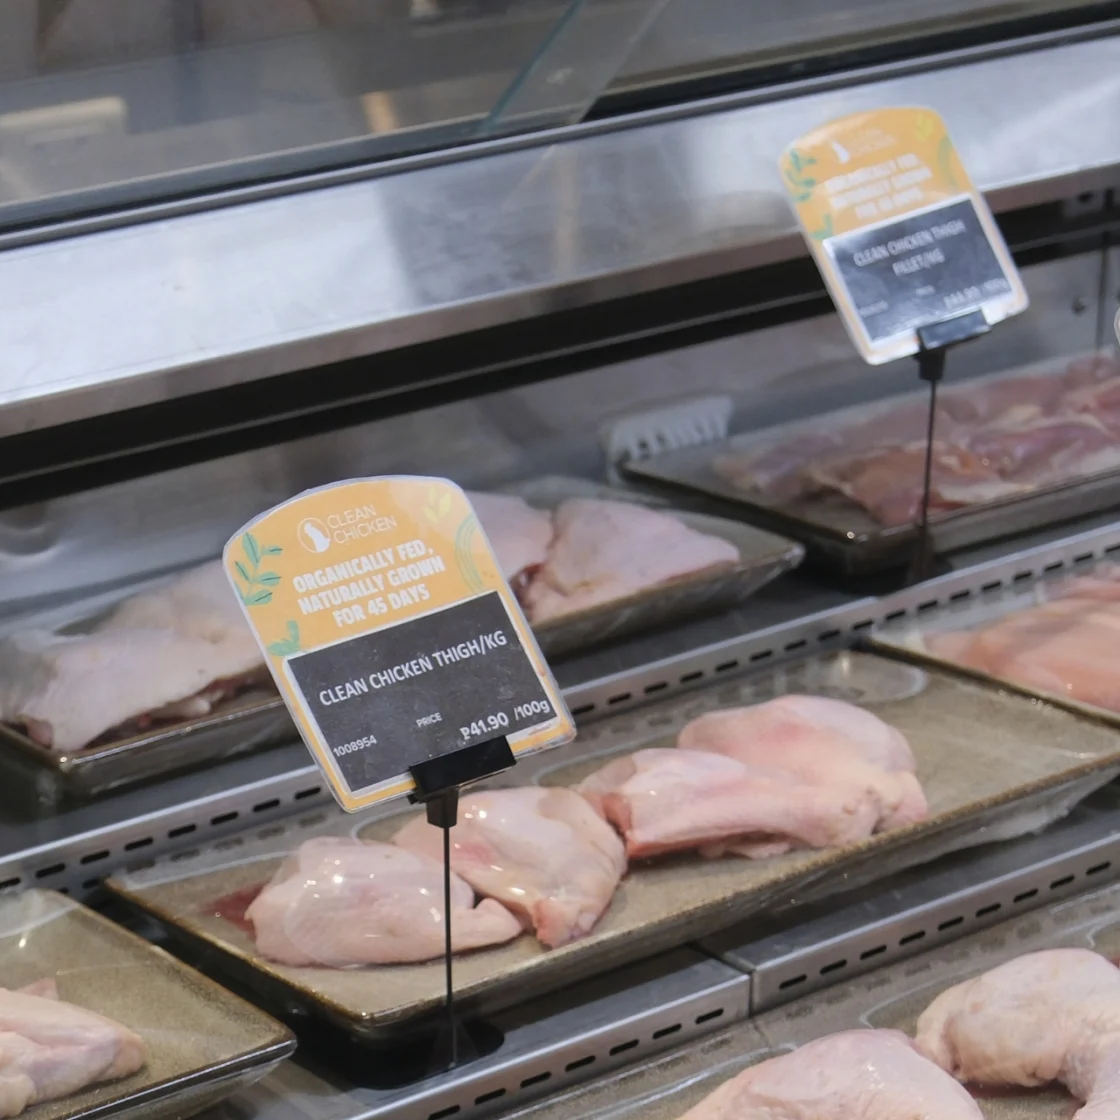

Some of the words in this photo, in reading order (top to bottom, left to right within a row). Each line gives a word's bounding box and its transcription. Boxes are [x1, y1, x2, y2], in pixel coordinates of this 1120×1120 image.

[327, 504, 377, 529] CLEAN
[333, 515, 398, 544] CHICKEN
[292, 548, 395, 593] ORGANICALLY
[396, 539, 434, 561] FED,
[297, 574, 385, 615] NATURALLY
[387, 556, 446, 587] GROWN
[332, 604, 366, 627] FOR
[367, 597, 388, 615] 45
[387, 583, 430, 609] DAYS
[319, 678, 369, 706] CLEAN
[368, 655, 433, 689] CHICKEN
[432, 630, 507, 667] THIGH/KG
[416, 712, 443, 728] PRICE
[513, 700, 550, 721] /100g
[333, 735, 377, 757] 1008954
